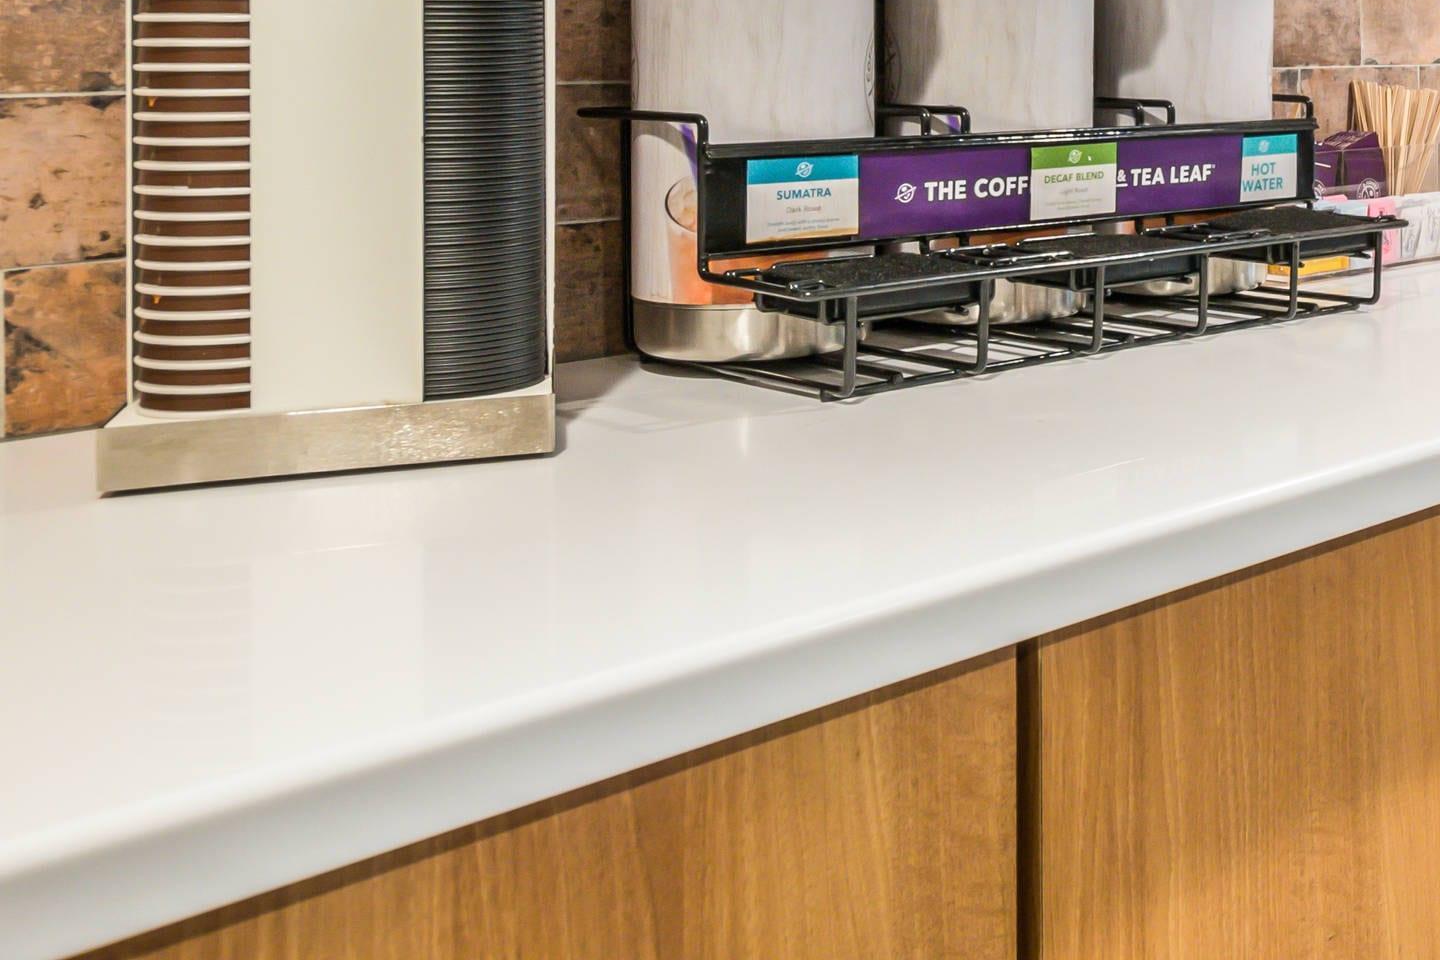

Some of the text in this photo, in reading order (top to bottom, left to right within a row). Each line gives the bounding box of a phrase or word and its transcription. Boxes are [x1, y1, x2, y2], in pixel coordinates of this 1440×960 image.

[1044, 170, 1105, 184] DECAF BLEND
[1251, 161, 1276, 177] HOT
[924, 163, 1213, 202] THE COFF & TEA LEAF
[1242, 177, 1283, 193] WATER
[776, 187, 832, 201] SUMATRA
